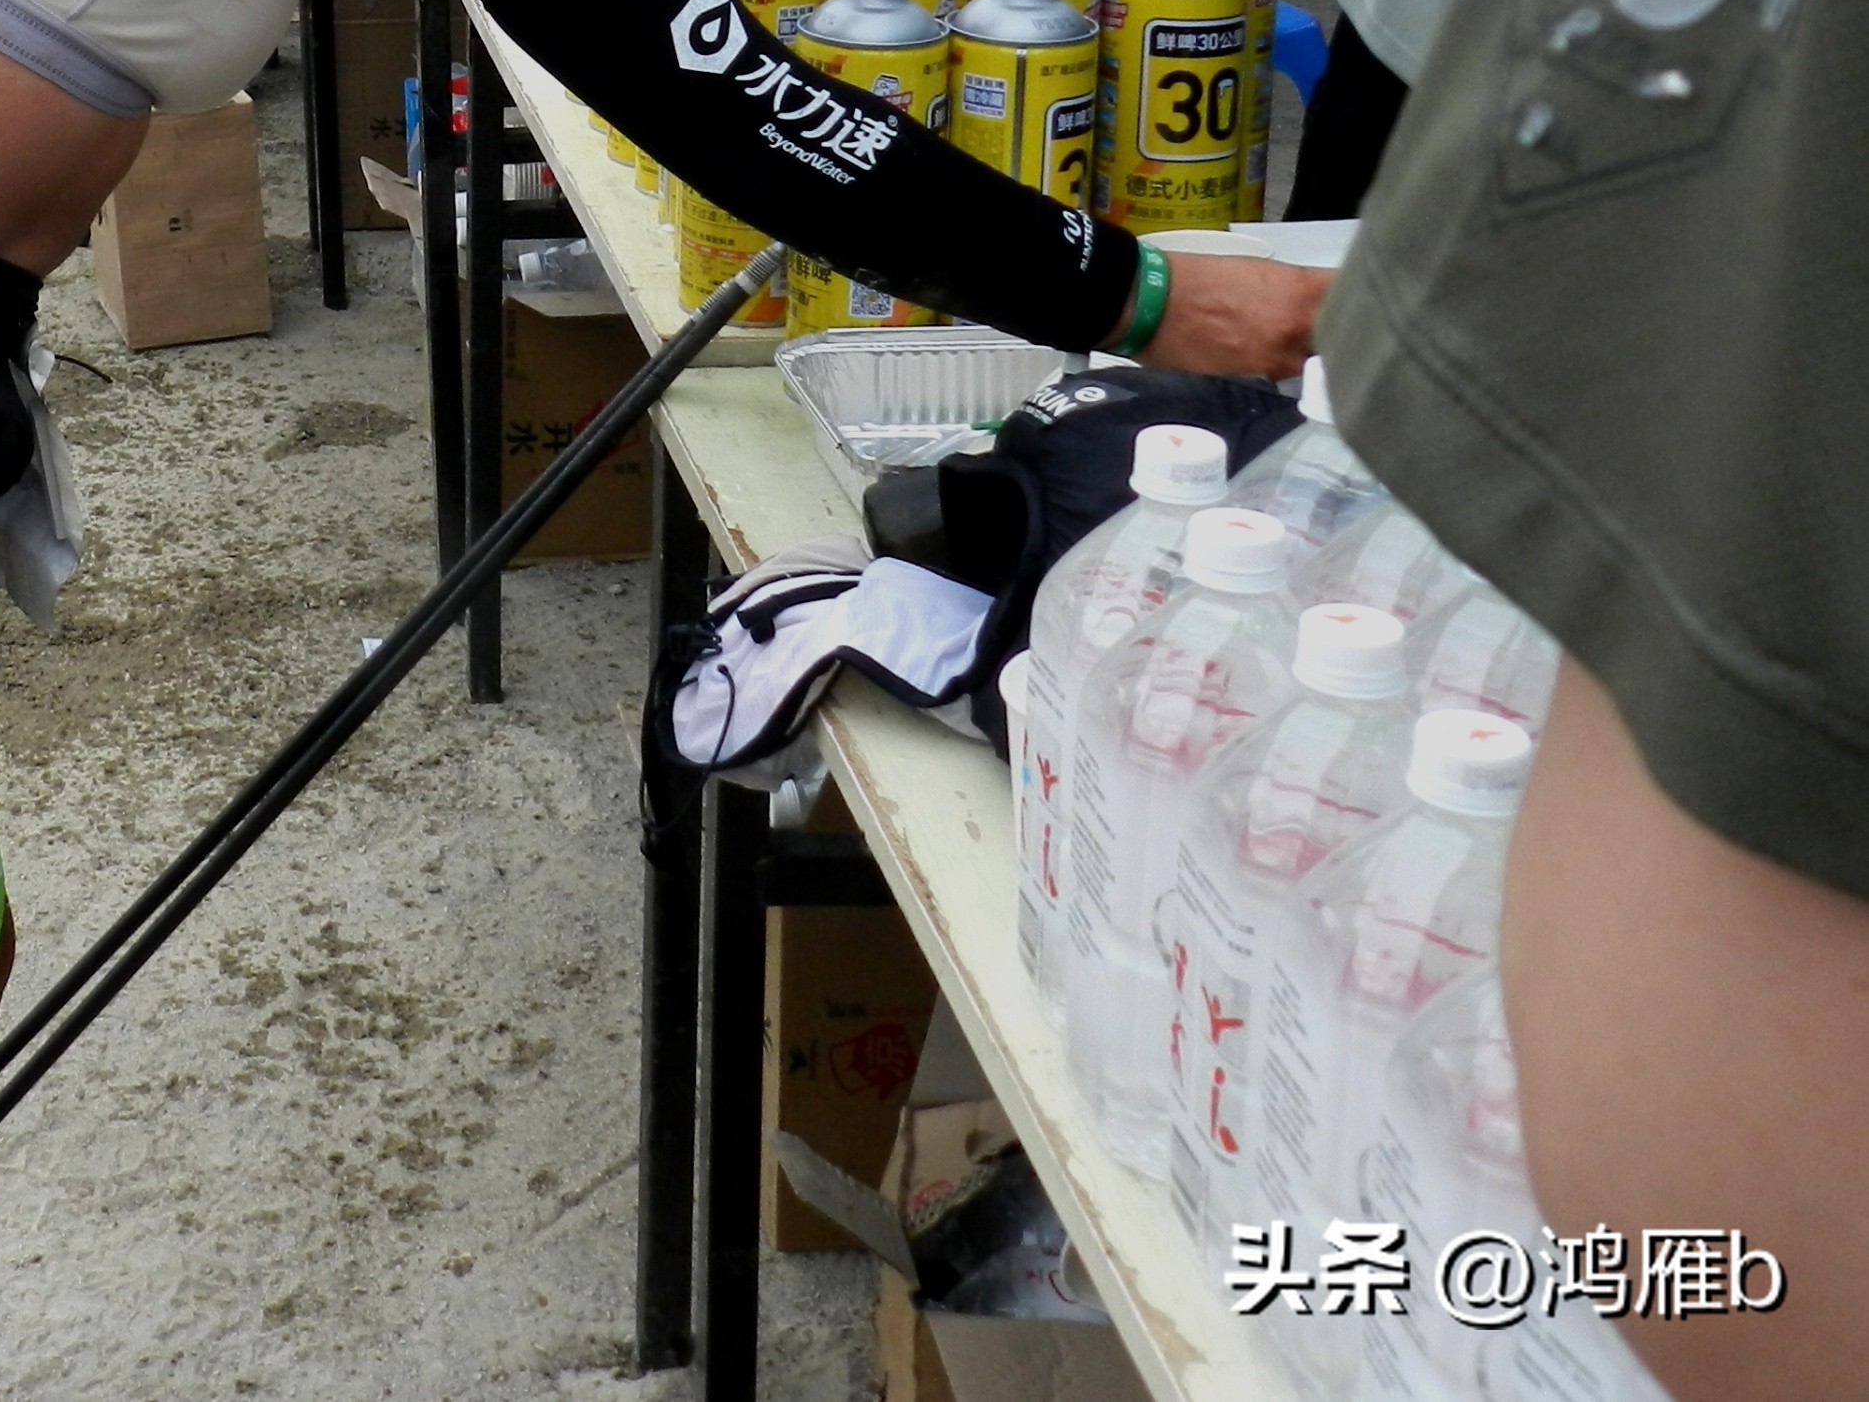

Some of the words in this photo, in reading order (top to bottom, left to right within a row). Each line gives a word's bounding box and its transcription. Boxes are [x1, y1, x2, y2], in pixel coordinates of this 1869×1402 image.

[735, 53, 898, 171] 水力速
[1154, 65, 1239, 145] 30
[758, 122, 857, 185] BeyondWater
